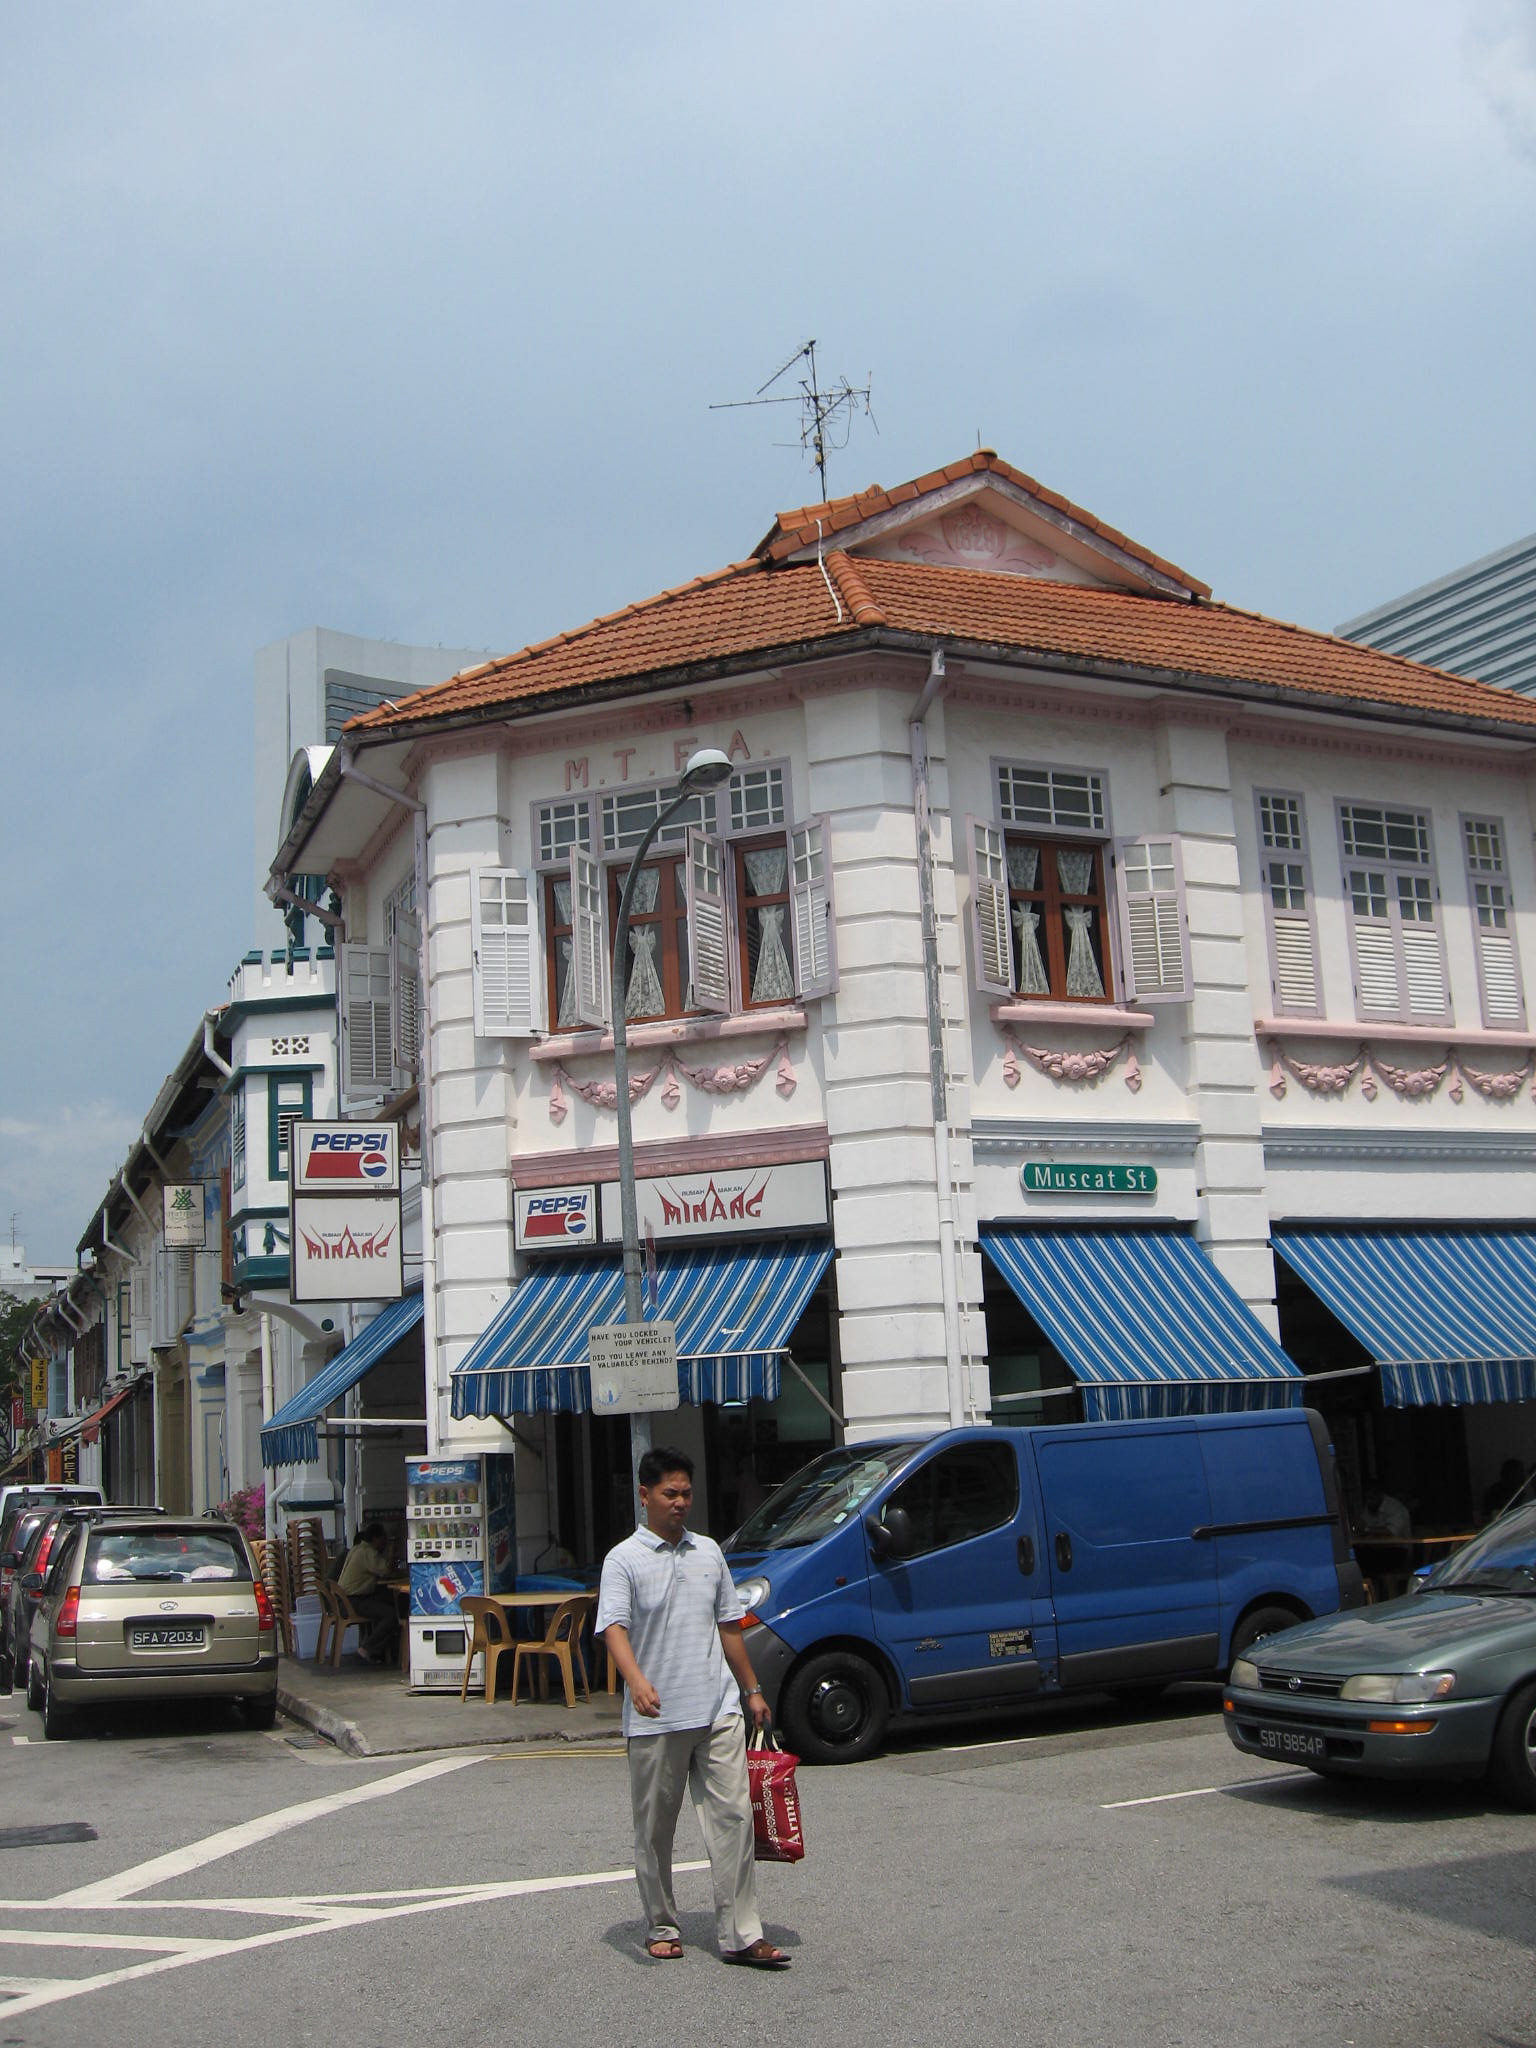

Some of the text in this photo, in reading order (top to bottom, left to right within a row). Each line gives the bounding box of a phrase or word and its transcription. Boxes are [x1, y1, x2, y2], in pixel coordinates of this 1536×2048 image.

[311, 1133, 388, 1151] PEPSI
[1034, 1166, 1148, 1189] Muscat St
[652, 1169, 773, 1225] MINANG
[682, 1184, 743, 1197] RUMAH MAKAN
[528, 1195, 587, 1215] PEPSI
[299, 1223, 397, 1260] MINANG
[591, 1333, 609, 1341] HAVE
[629, 1329, 658, 1338] LOCKED
[614, 1336, 671, 1347] YOUR VEHICLE?
[597, 1357, 673, 1368] VALUABLES BEHIND?
[609, 1352, 623, 1360] YOU
[625, 1350, 647, 1359] LEAVE
[431, 1466, 466, 1476] PEPSI
[1260, 1729, 1324, 1755] SBT9854P
